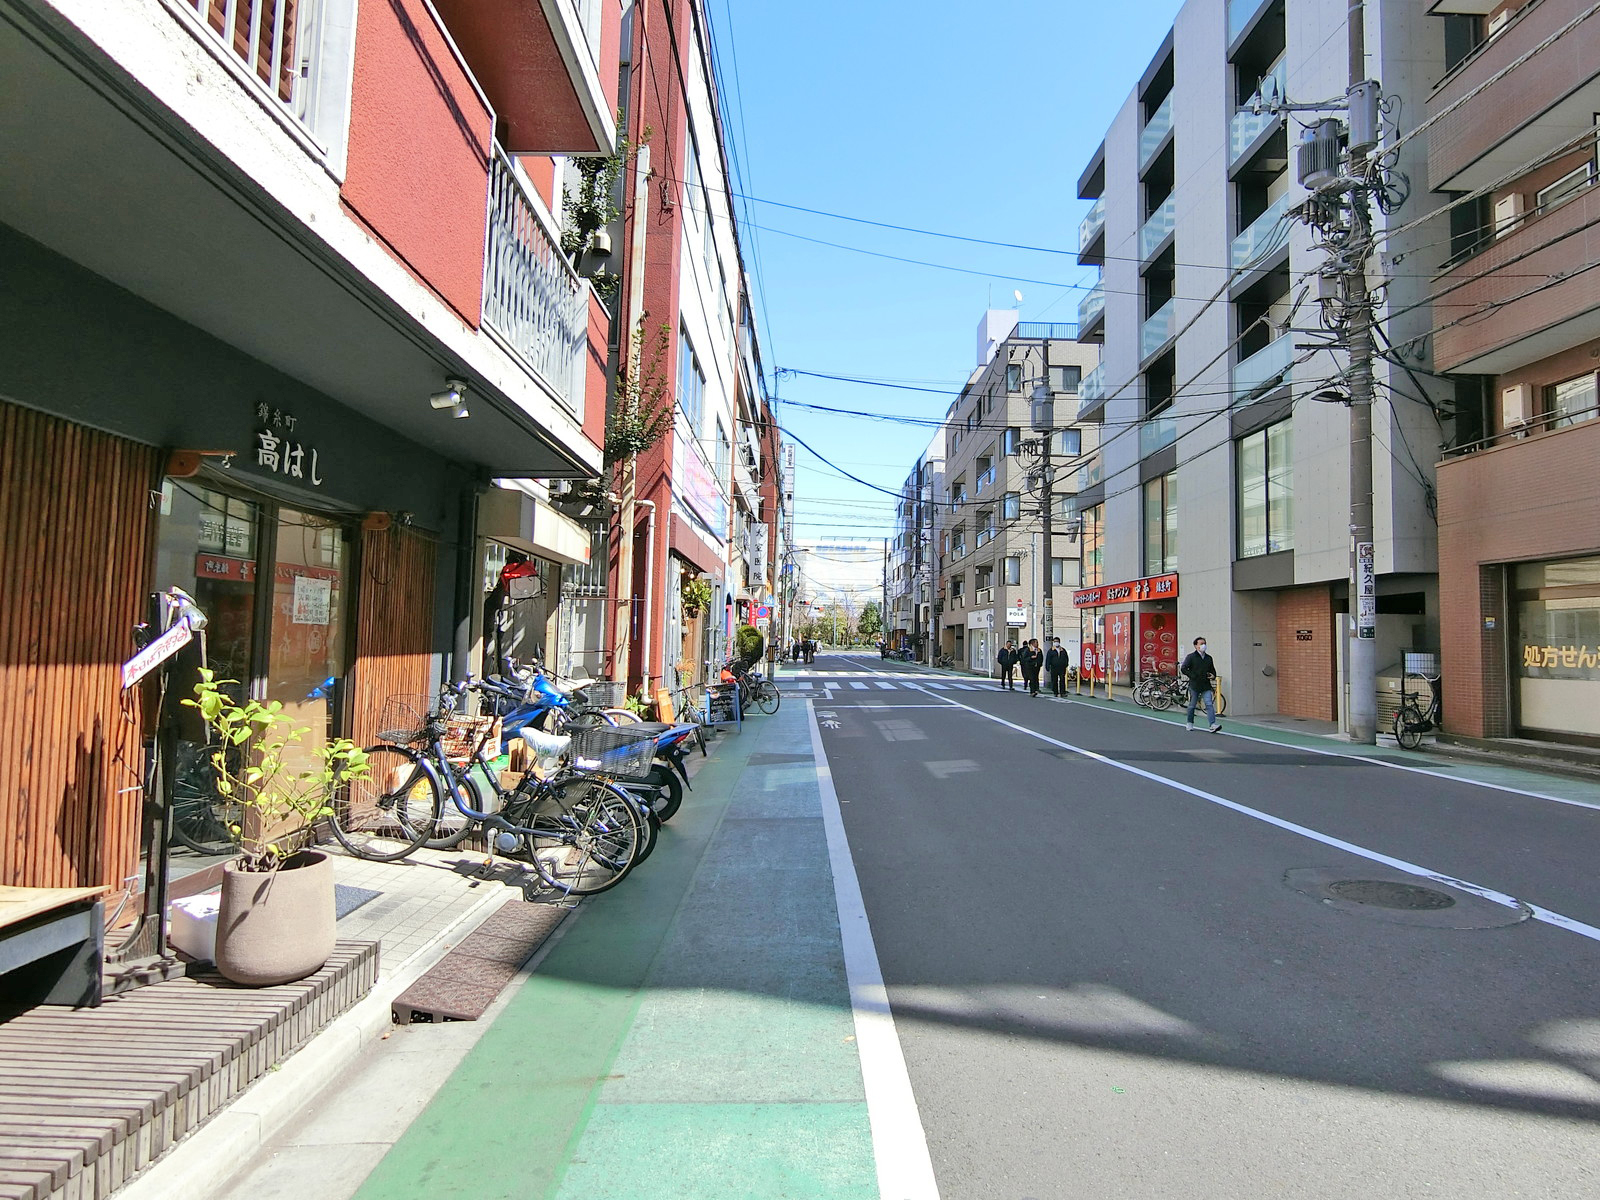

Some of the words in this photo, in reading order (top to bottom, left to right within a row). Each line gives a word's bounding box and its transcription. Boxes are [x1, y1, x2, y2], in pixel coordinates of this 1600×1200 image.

[257, 402, 298, 433] 錦糸町
[257, 429, 323, 486] 高はし
[752, 528, 763, 580] 大室医院
[1134, 579, 1150, 599] 中本
[1363, 563, 1374, 595] 紀久屋
[1523, 645, 1600, 668] 処方せん
